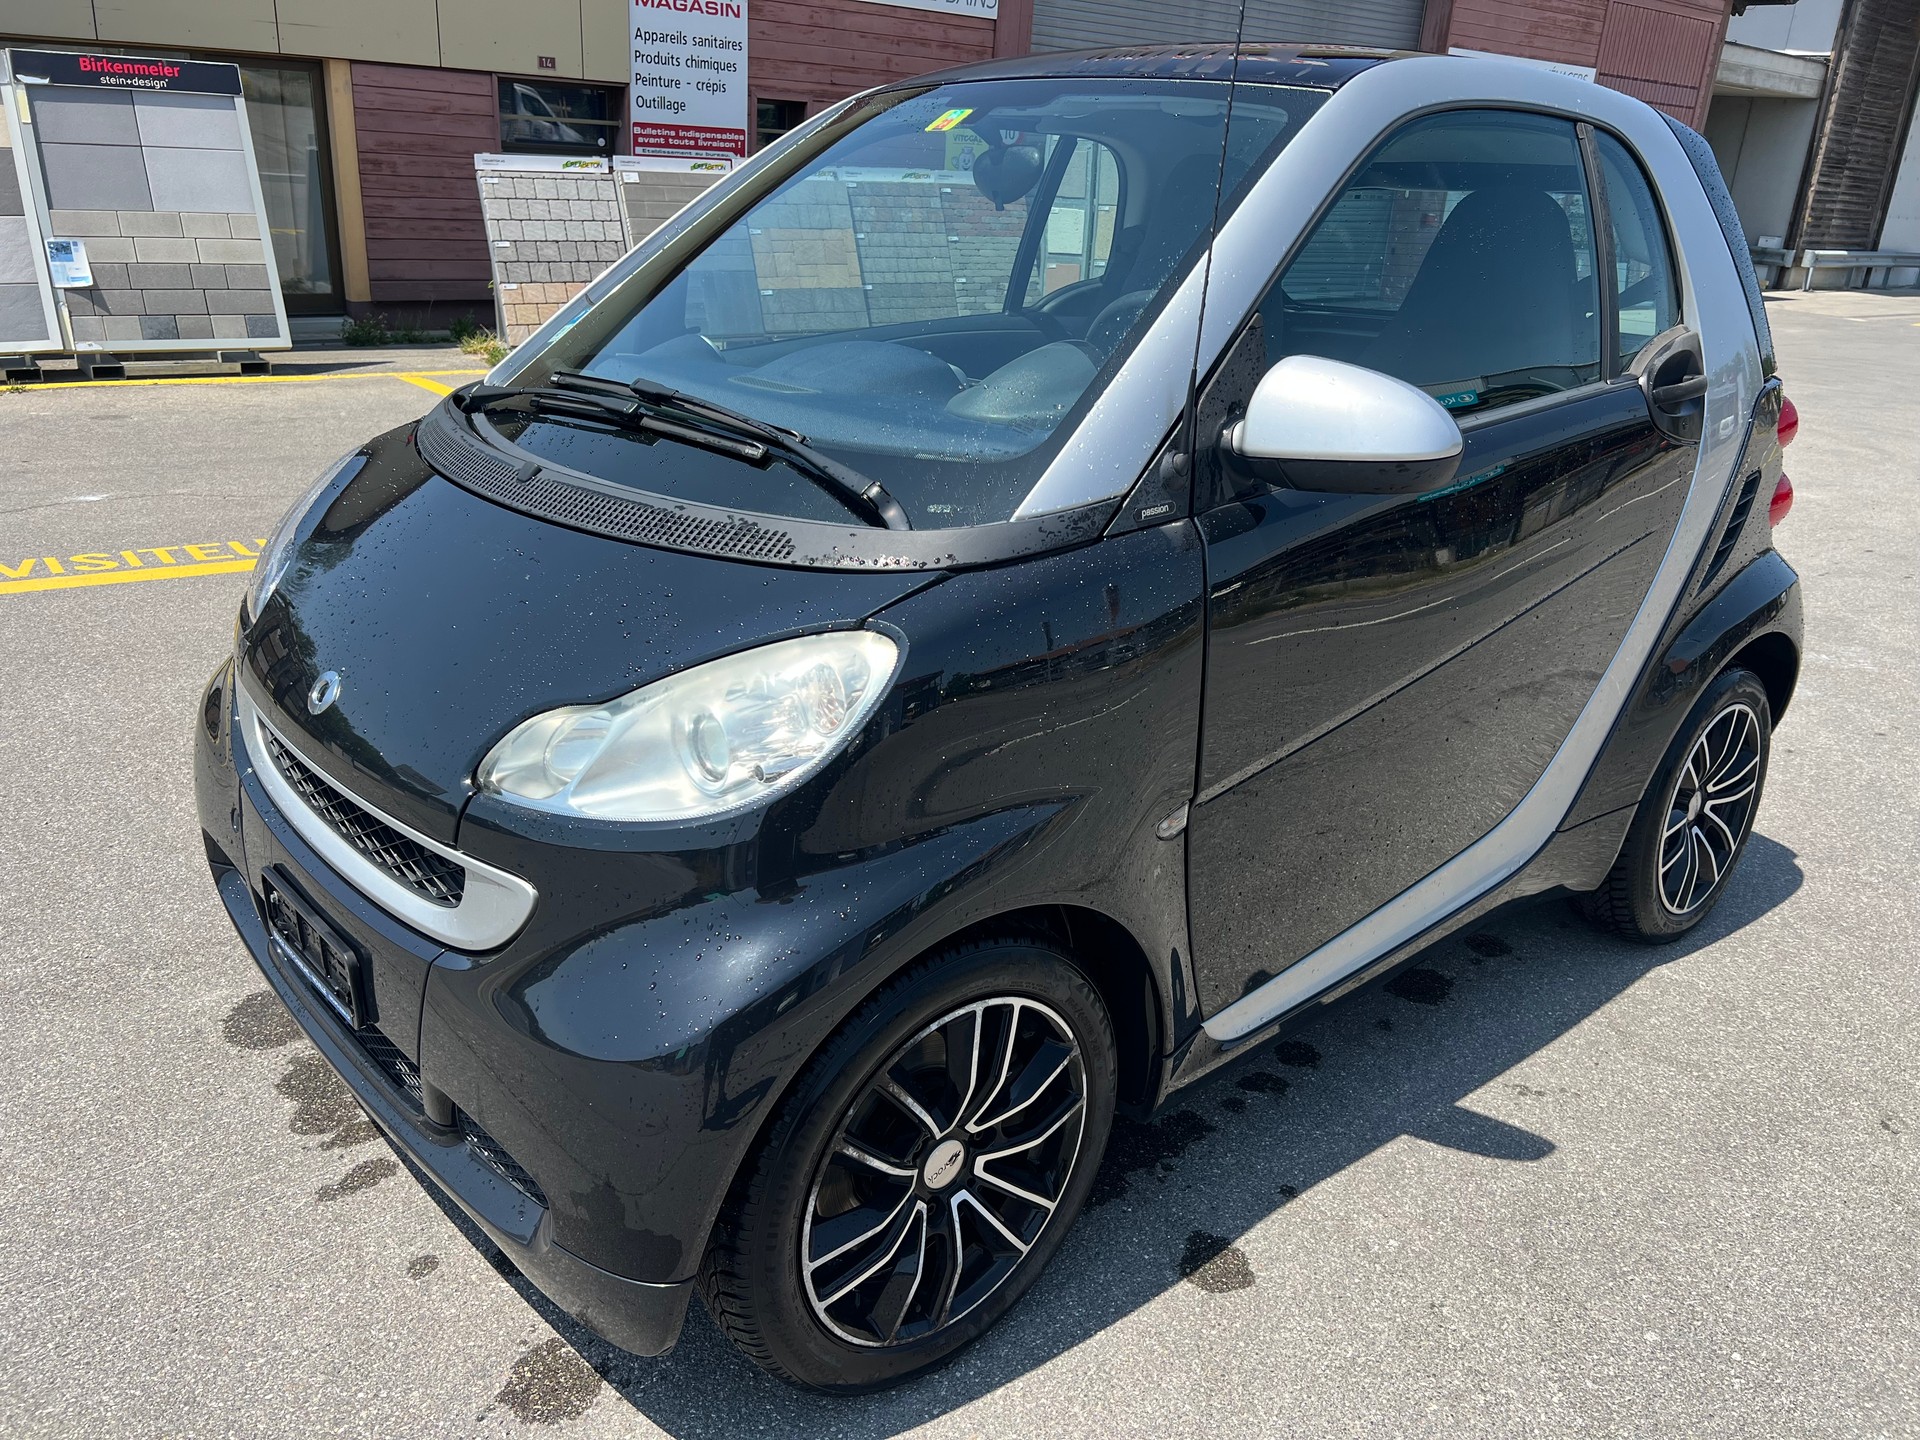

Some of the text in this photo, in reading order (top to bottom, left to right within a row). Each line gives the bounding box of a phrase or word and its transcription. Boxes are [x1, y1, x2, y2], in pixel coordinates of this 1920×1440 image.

[634, 27, 743, 52] Appareils sanitaires
[79, 57, 180, 78] Birkenmeier
[542, 58, 552, 67] 14
[634, 50, 737, 75] Produits chimiques
[635, 73, 681, 89] Peinture
[696, 78, 727, 96] crépis
[635, 95, 686, 115] Outillage
[633, 126, 744, 141] Bulletins indispensables
[638, 136, 665, 145] avant
[669, 138, 695, 146] toute
[698, 139, 735, 149] livraison
[642, 148, 693, 157] Etablissement
[706, 150, 731, 158] bureau.
[1141, 504, 1169, 520] passion
